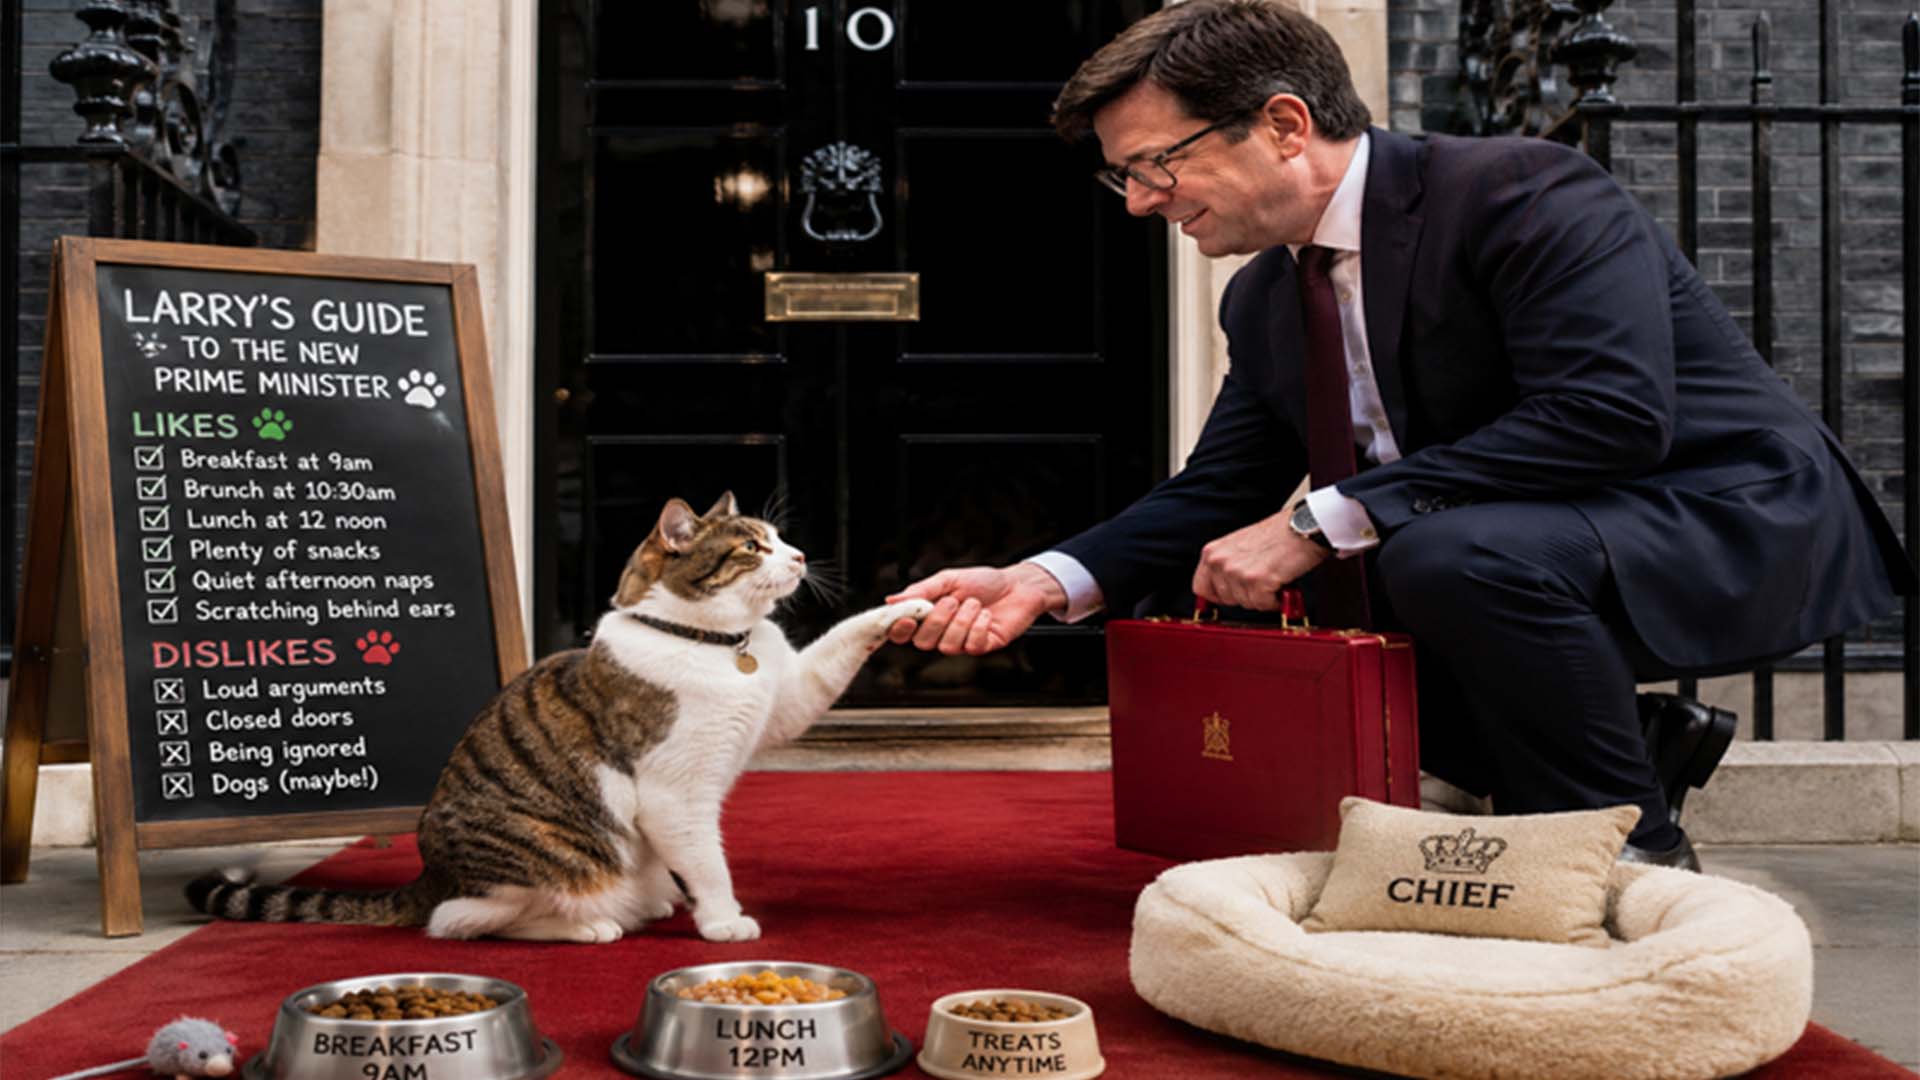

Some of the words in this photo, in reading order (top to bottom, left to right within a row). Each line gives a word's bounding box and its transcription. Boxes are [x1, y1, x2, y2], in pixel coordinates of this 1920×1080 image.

[804, 6, 895, 51] 10
[124, 289, 295, 330] LARRY'S
[312, 299, 429, 337] GUIDE
[181, 336, 219, 359] TO
[232, 337, 287, 363] THE
[299, 342, 359, 365] NEW
[154, 367, 246, 394] PRIME
[259, 372, 391, 399] MINISTER
[132, 412, 239, 439] LIKES
[181, 449, 288, 470] Breakfast
[298, 451, 320, 470] at
[328, 453, 373, 471] 9am
[184, 478, 264, 500] Brunch
[273, 480, 295, 500] at
[305, 481, 396, 501] 10:30am
[187, 509, 256, 530] Lunch
[266, 511, 288, 530] at
[299, 511, 326, 529] 12
[335, 515, 387, 530] noon
[190, 540, 263, 565] Plenty
[274, 540, 298, 560] of
[307, 541, 381, 560] snacks
[192, 570, 256, 591] Quiet
[265, 569, 376, 590] afternoon
[385, 573, 434, 594] naps
[195, 600, 319, 625] Scratching
[328, 598, 399, 619] behind
[409, 602, 456, 618] ears
[152, 638, 337, 669] DISLIKES
[203, 678, 259, 700] Loud
[269, 677, 386, 703] arguments
[205, 708, 282, 731] Closed
[291, 708, 353, 729] doors
[208, 741, 274, 767] Being
[282, 736, 367, 765] ignored
[212, 773, 269, 799] Dogs
[279, 765, 379, 797] (maybe!)
[1387, 877, 1515, 910] CHIEF
[716, 1018, 817, 1041] LUNCH
[968, 1031, 1061, 1051] TREATS
[313, 1029, 477, 1057] BREAKFAST
[728, 1046, 805, 1067] 12PM
[961, 1053, 1067, 1073] ANYTIME
[362, 1063, 427, 1080] 9AM
